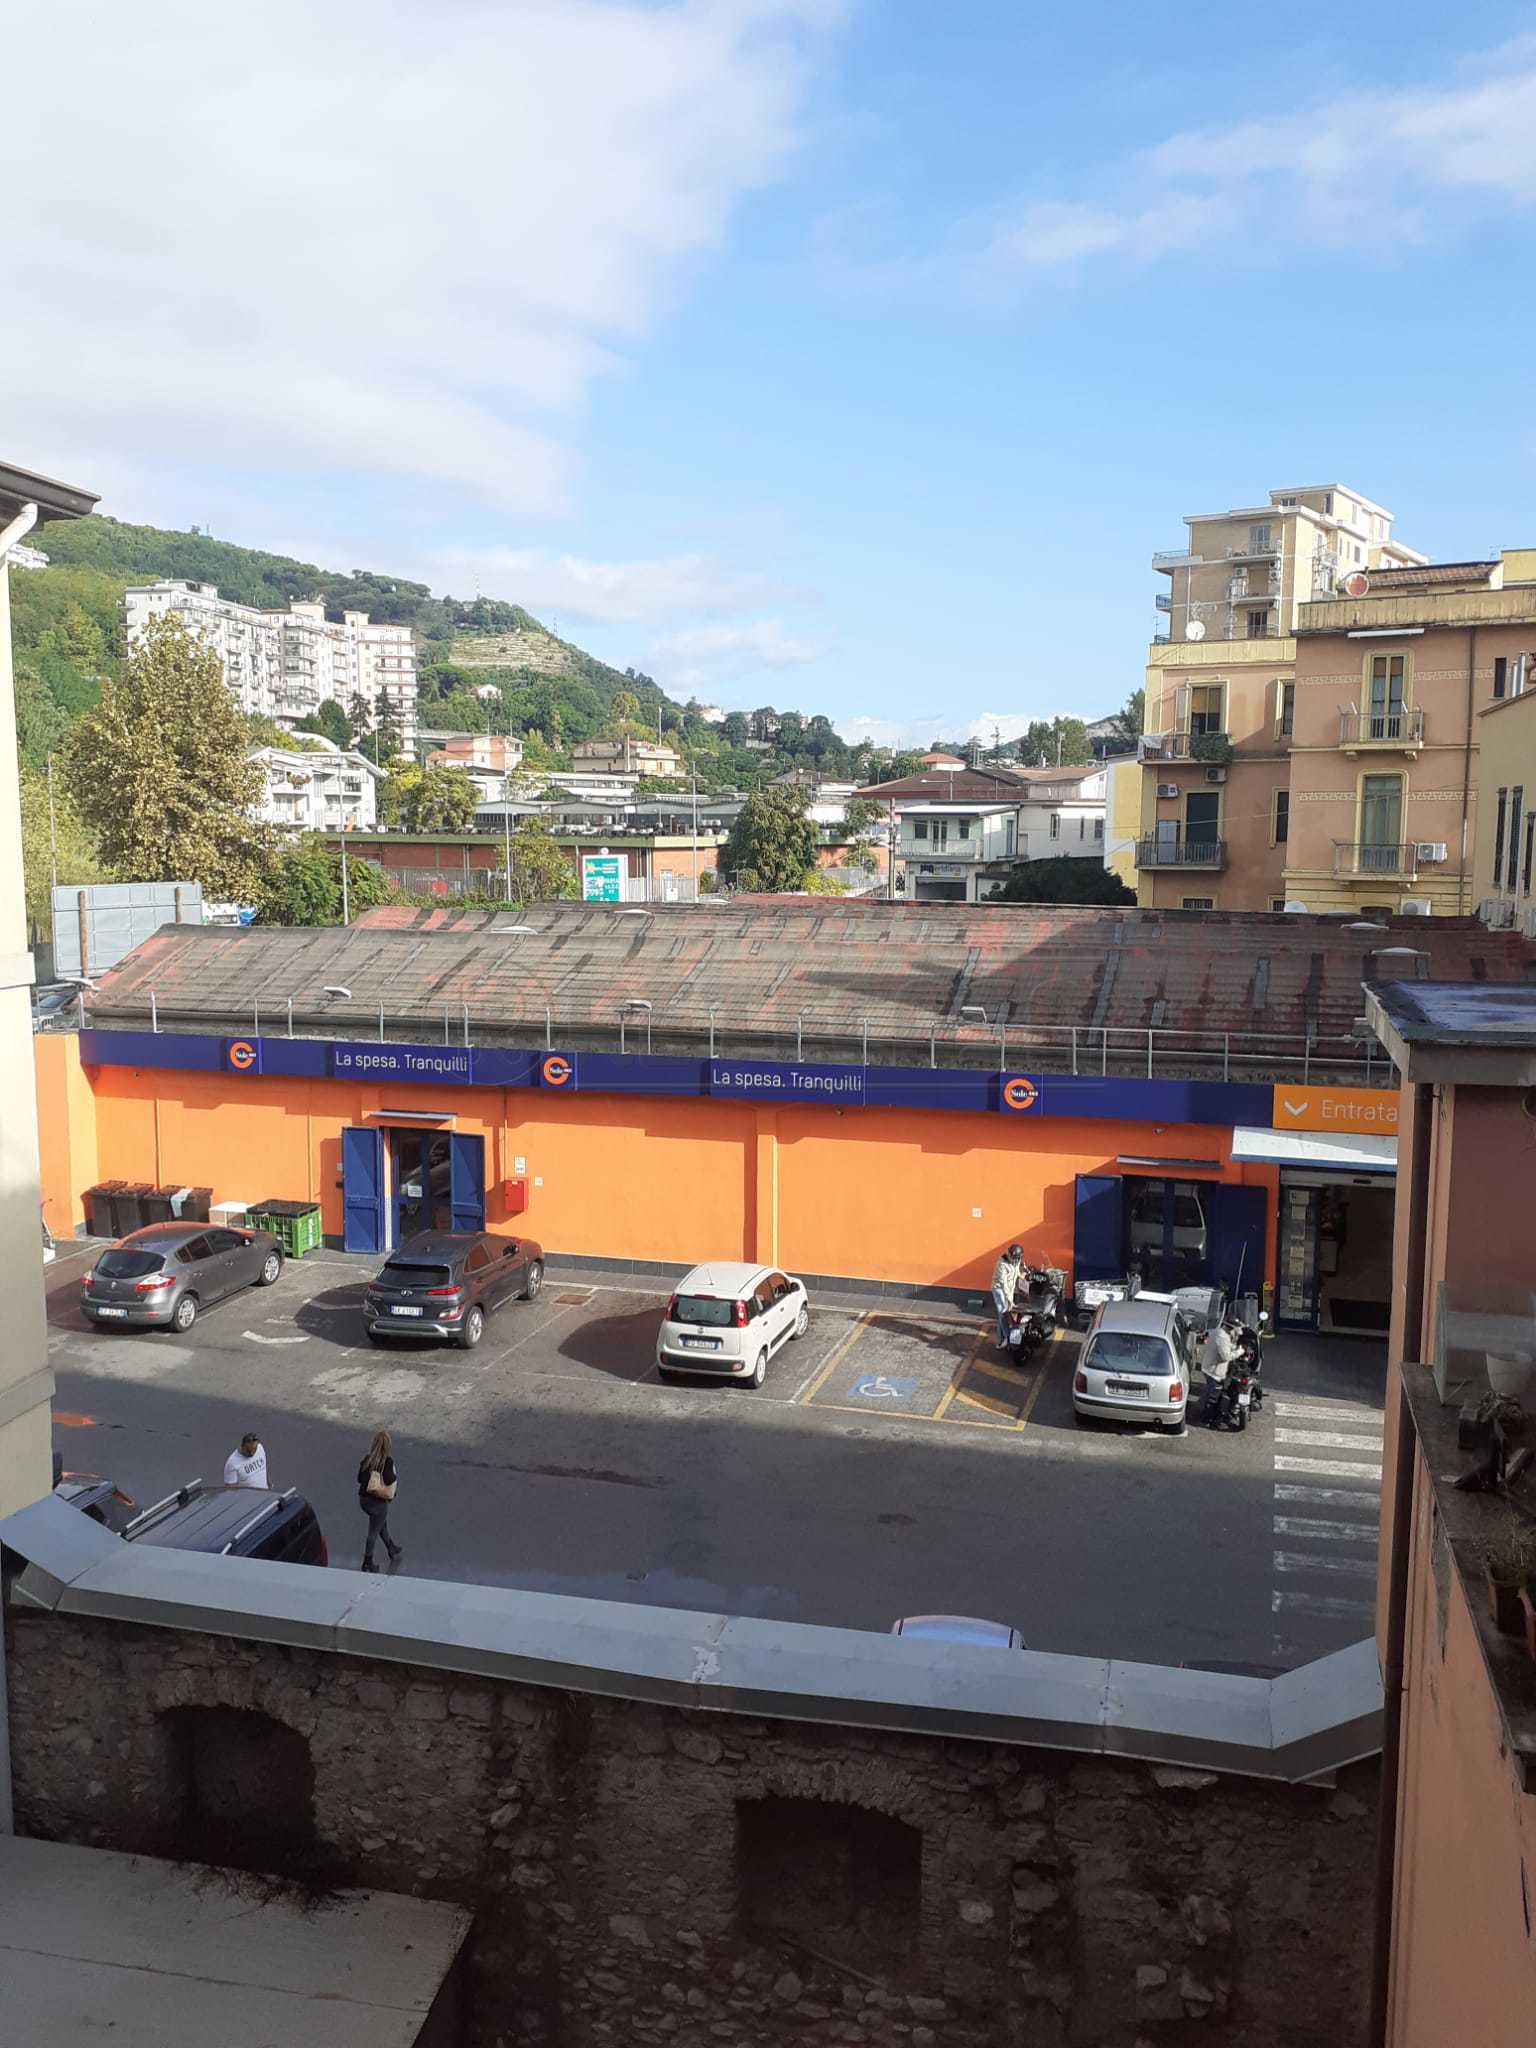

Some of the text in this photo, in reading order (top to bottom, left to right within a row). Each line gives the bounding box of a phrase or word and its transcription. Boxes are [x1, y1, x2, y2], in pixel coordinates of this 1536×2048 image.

[335, 1051, 467, 1074] La spesa. Tranquilli
[713, 1068, 862, 1094] La spesa. Tranquilli
[1321, 1099, 1399, 1122] Entrata
